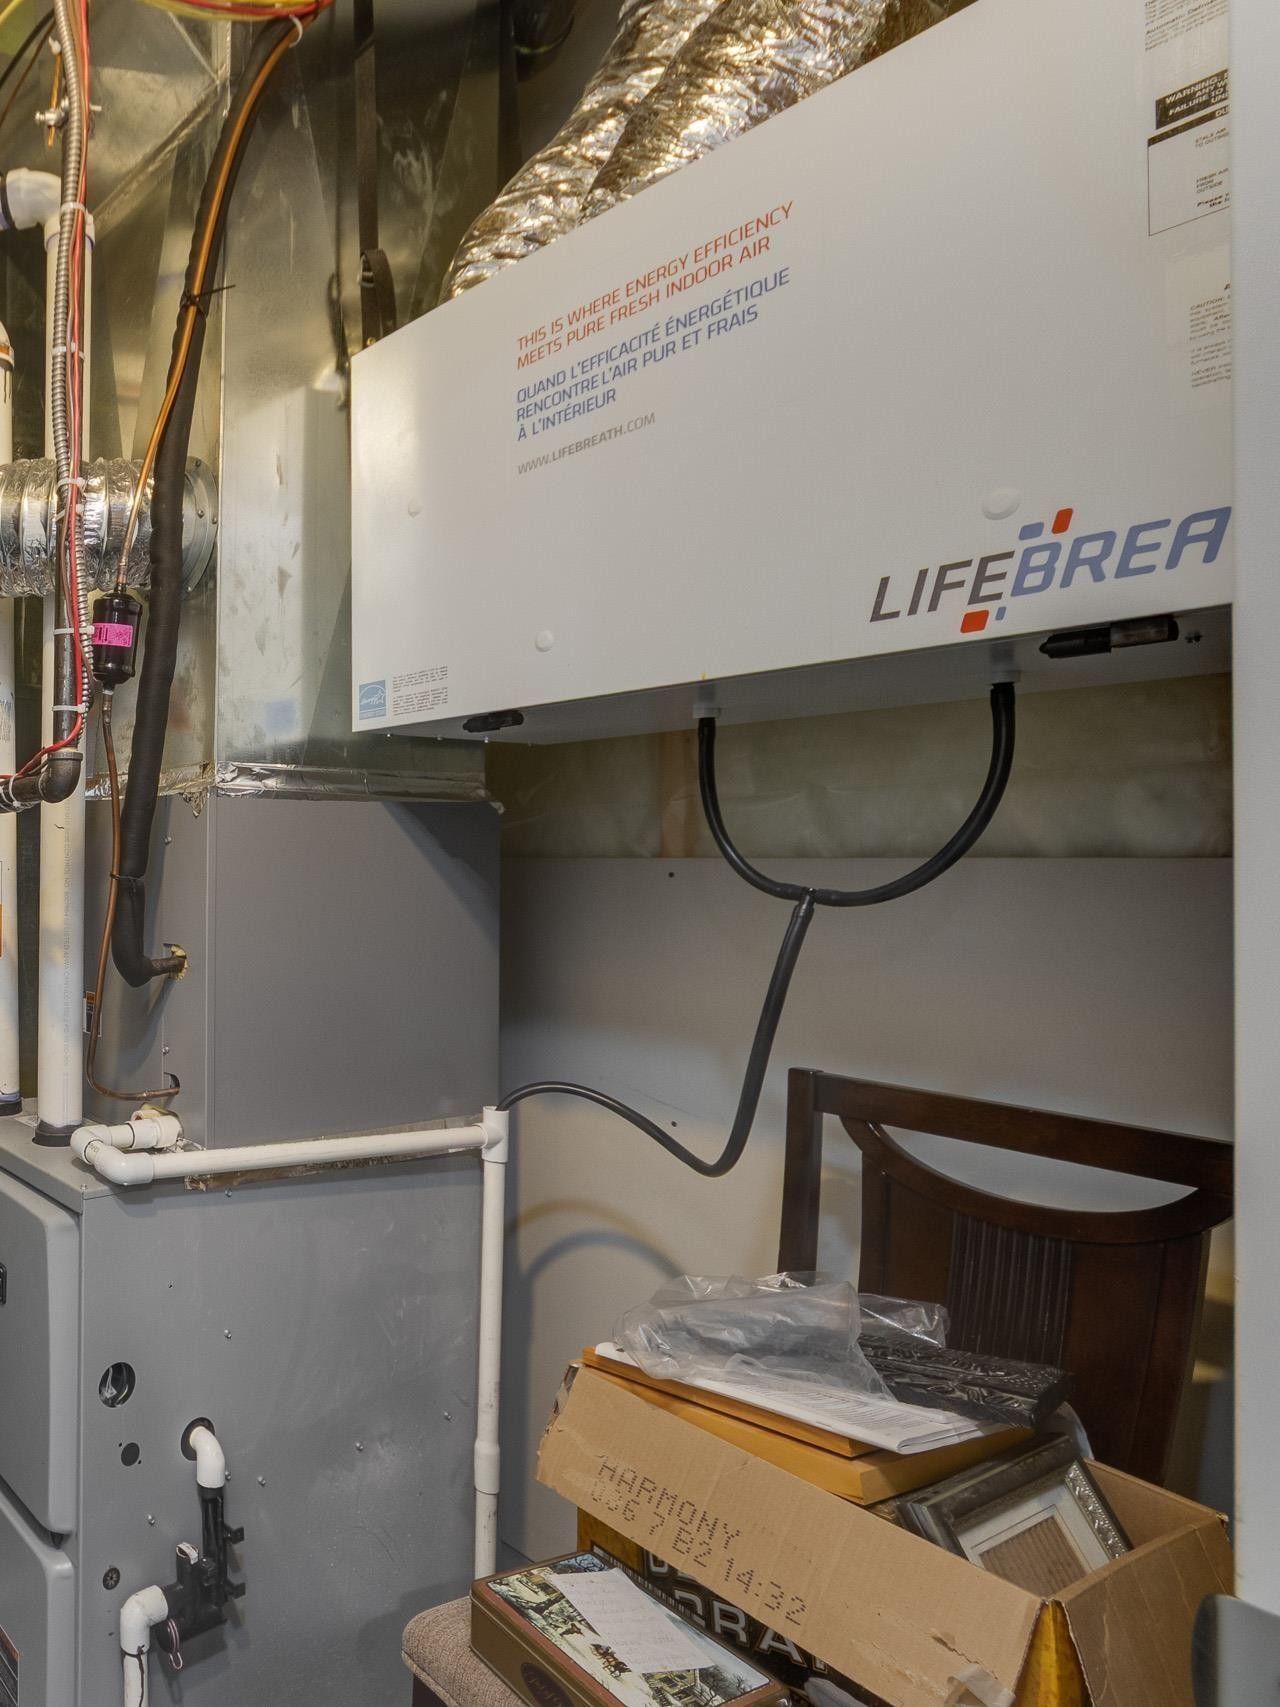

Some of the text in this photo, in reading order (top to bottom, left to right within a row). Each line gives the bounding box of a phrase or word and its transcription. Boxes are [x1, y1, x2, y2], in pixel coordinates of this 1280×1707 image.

[517, 201, 794, 351] THIS IS WHERE ENERGY EFFICIENCY
[517, 235, 770, 370] MEETS PURE FRESH INDOOR AIR
[516, 304, 758, 422] RENCONTRE L'AIR PUR ET FRAIS
[517, 267, 791, 404] QUAND L'EFFICACITÉ ÉNERGÉTIQUE
[517, 388, 617, 441] À L'INTÉRIEUR
[518, 412, 655, 475] WWW.LIFEBREATH.COM
[597, 1456, 741, 1551] HARMONY
[671, 1527, 713, 1568] B2
[724, 1557, 807, 1626] 14:32
